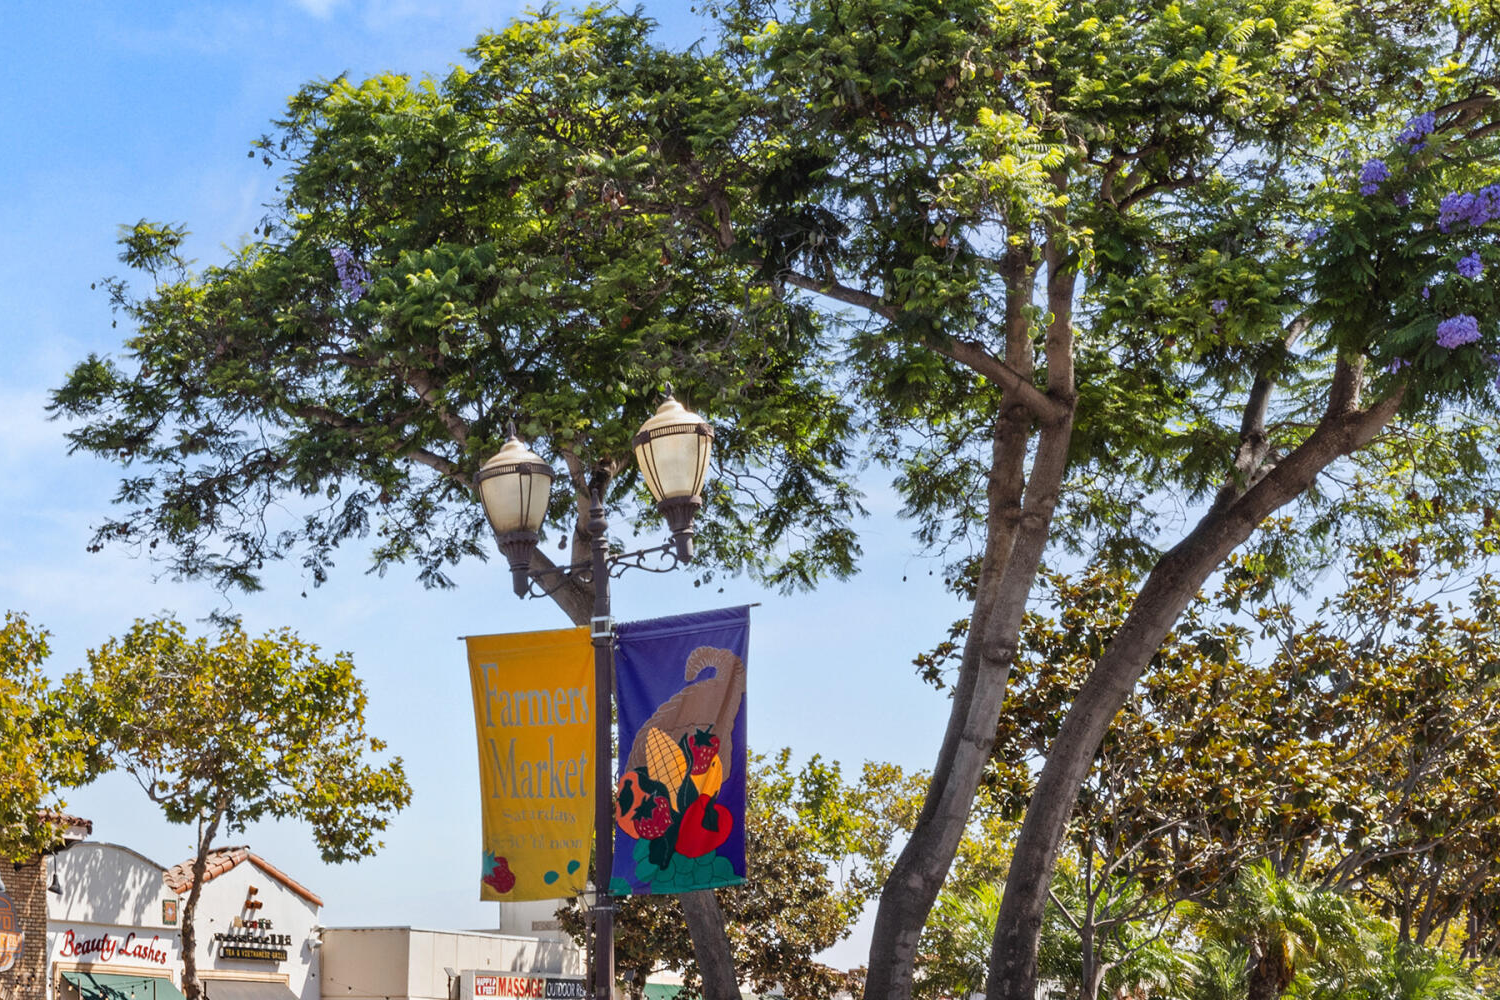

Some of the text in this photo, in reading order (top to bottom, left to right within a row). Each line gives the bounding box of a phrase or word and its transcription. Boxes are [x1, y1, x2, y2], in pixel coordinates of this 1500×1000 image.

[480, 663, 590, 728] Farmers
[489, 735, 588, 798] Market
[502, 804, 577, 824] Saturdays
[59, 929, 167, 964] Beauty Lashes
[498, 977, 543, 998] MASSAGE
[546, 982, 575, 997] OUTDOOR
